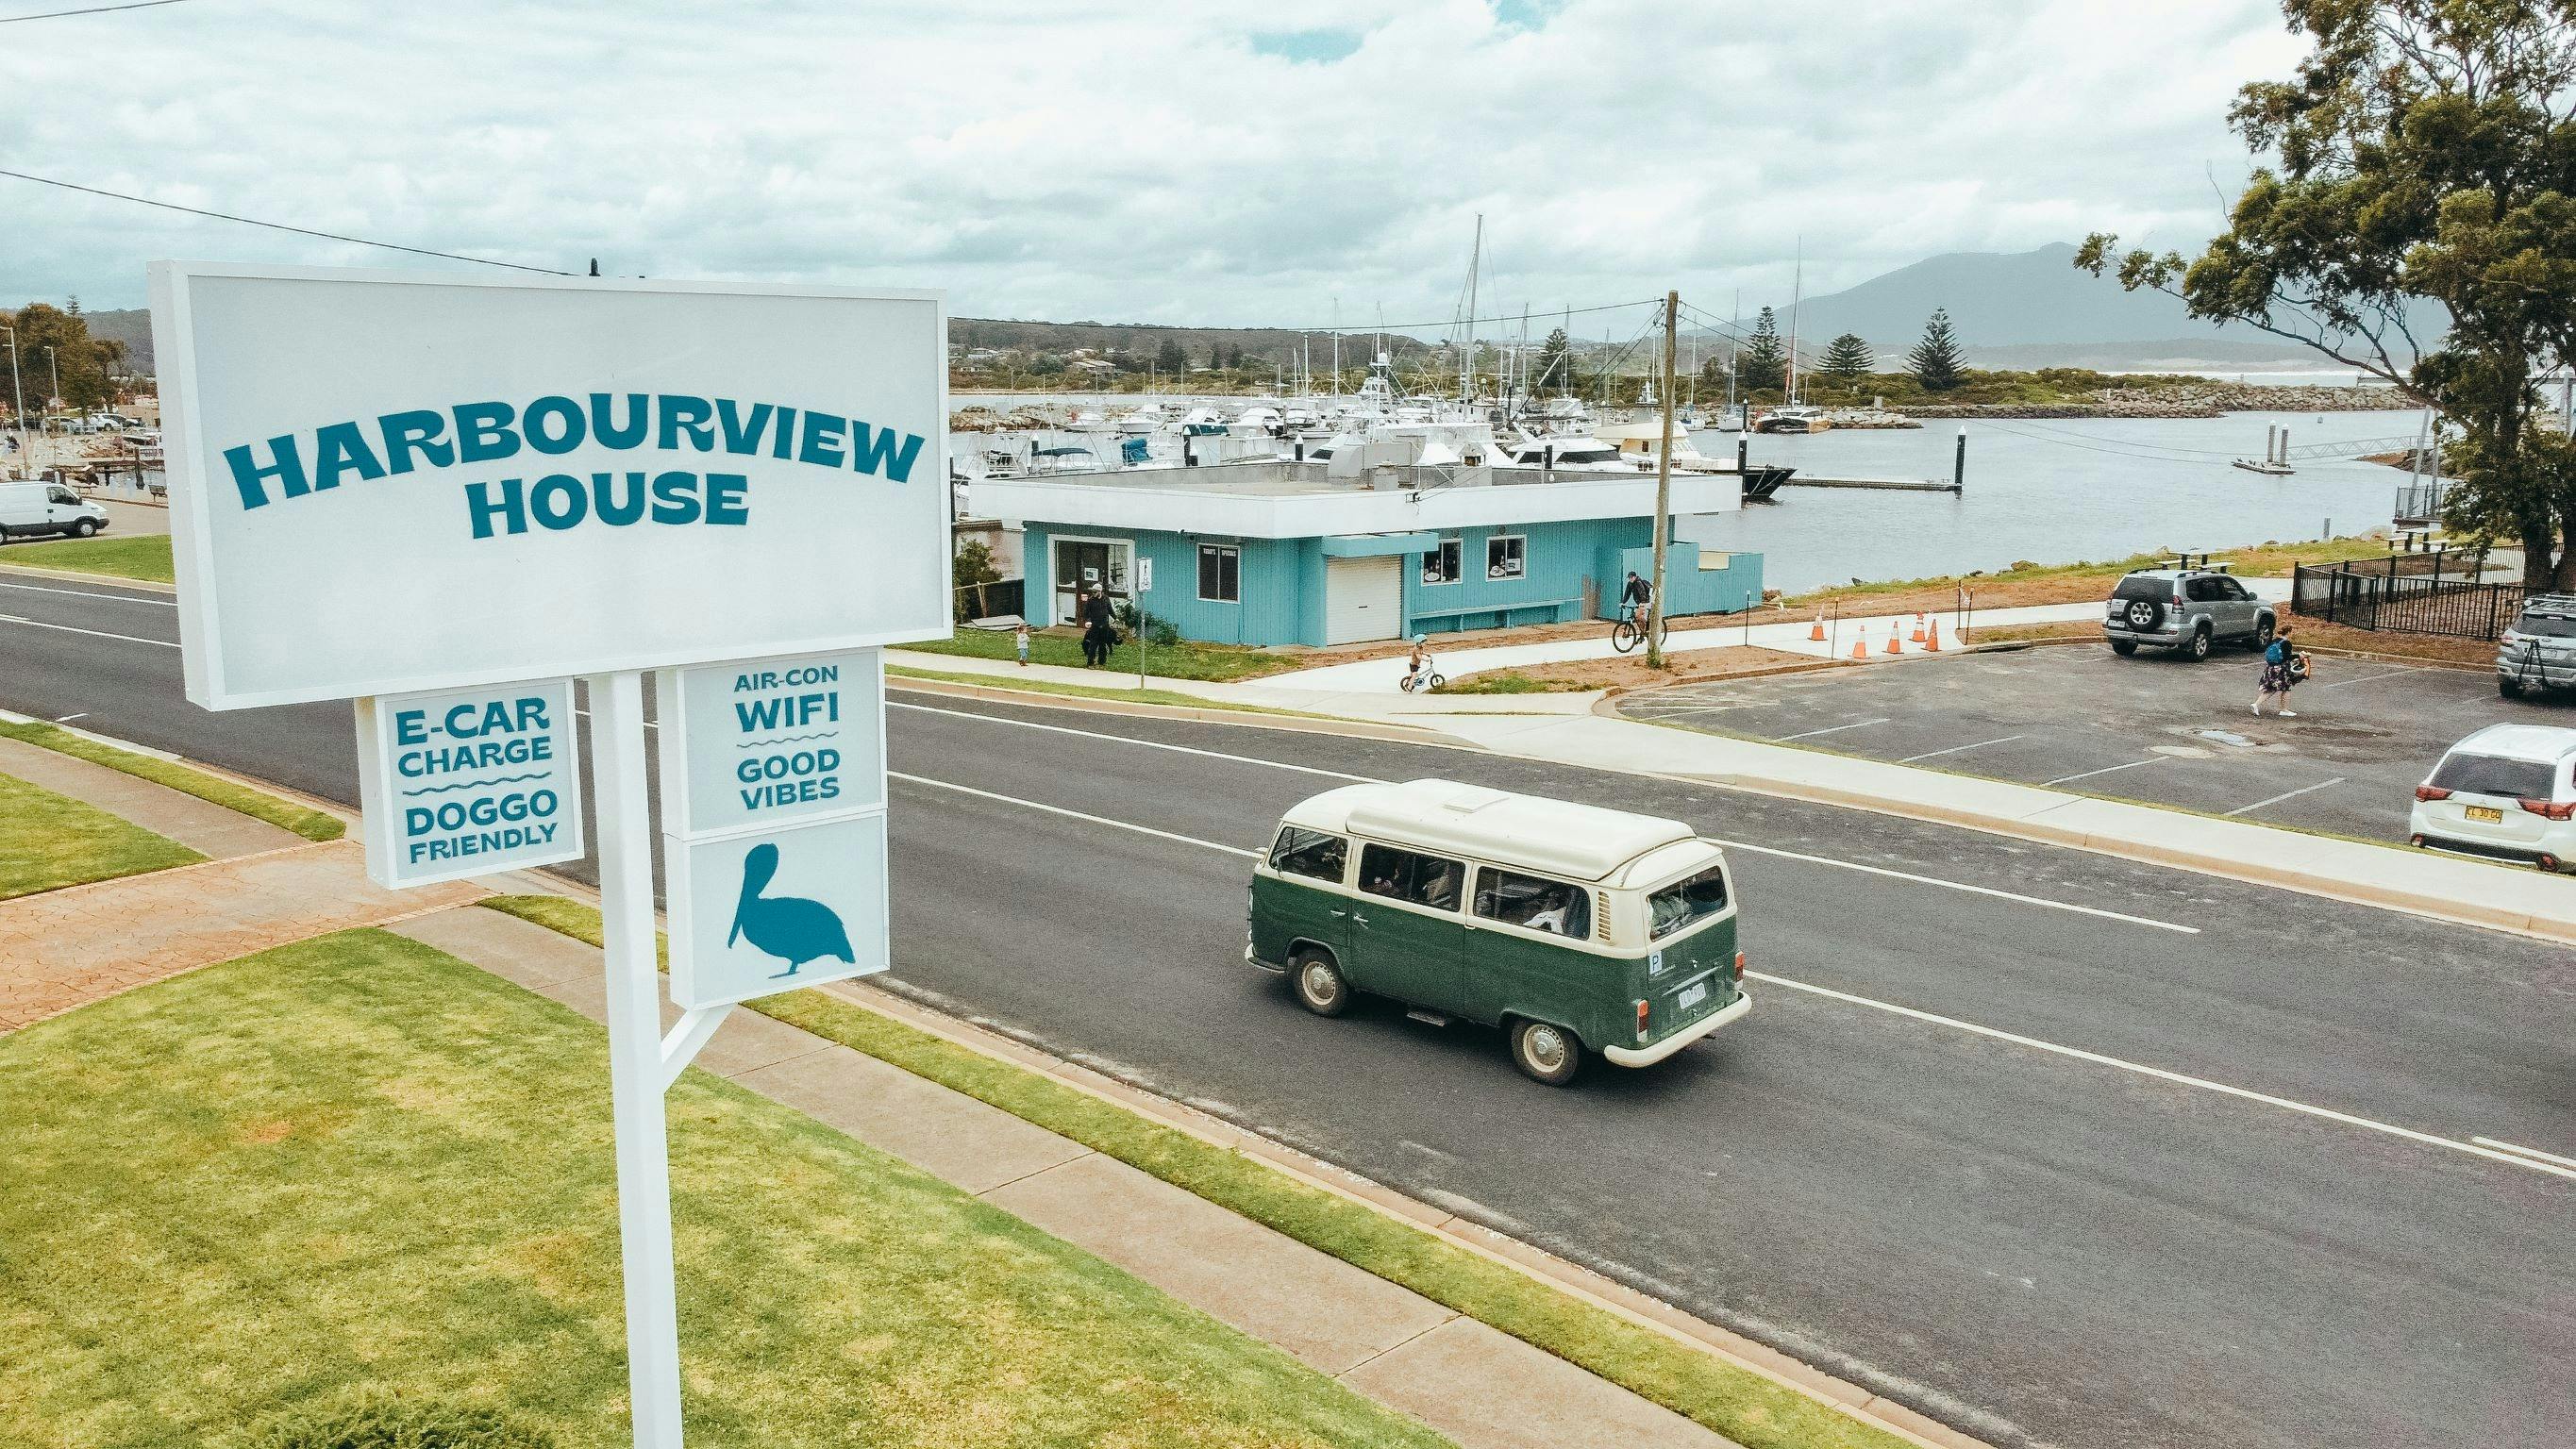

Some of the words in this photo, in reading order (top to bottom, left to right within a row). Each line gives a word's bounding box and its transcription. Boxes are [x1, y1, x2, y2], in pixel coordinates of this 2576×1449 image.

[224, 393, 925, 511] HARBOURVIEW
[465, 473, 750, 541] HOUSE
[734, 665, 840, 692] AIR-CON
[396, 697, 551, 746] E-CAR
[735, 692, 840, 733] WIFI
[397, 736, 553, 778] CHARGE
[737, 748, 842, 784] GOOD
[406, 790, 559, 838] DOGGO
[741, 776, 842, 811] VIBES
[410, 823, 559, 865] FRIENDLY
[1652, 955, 1659, 972] P
